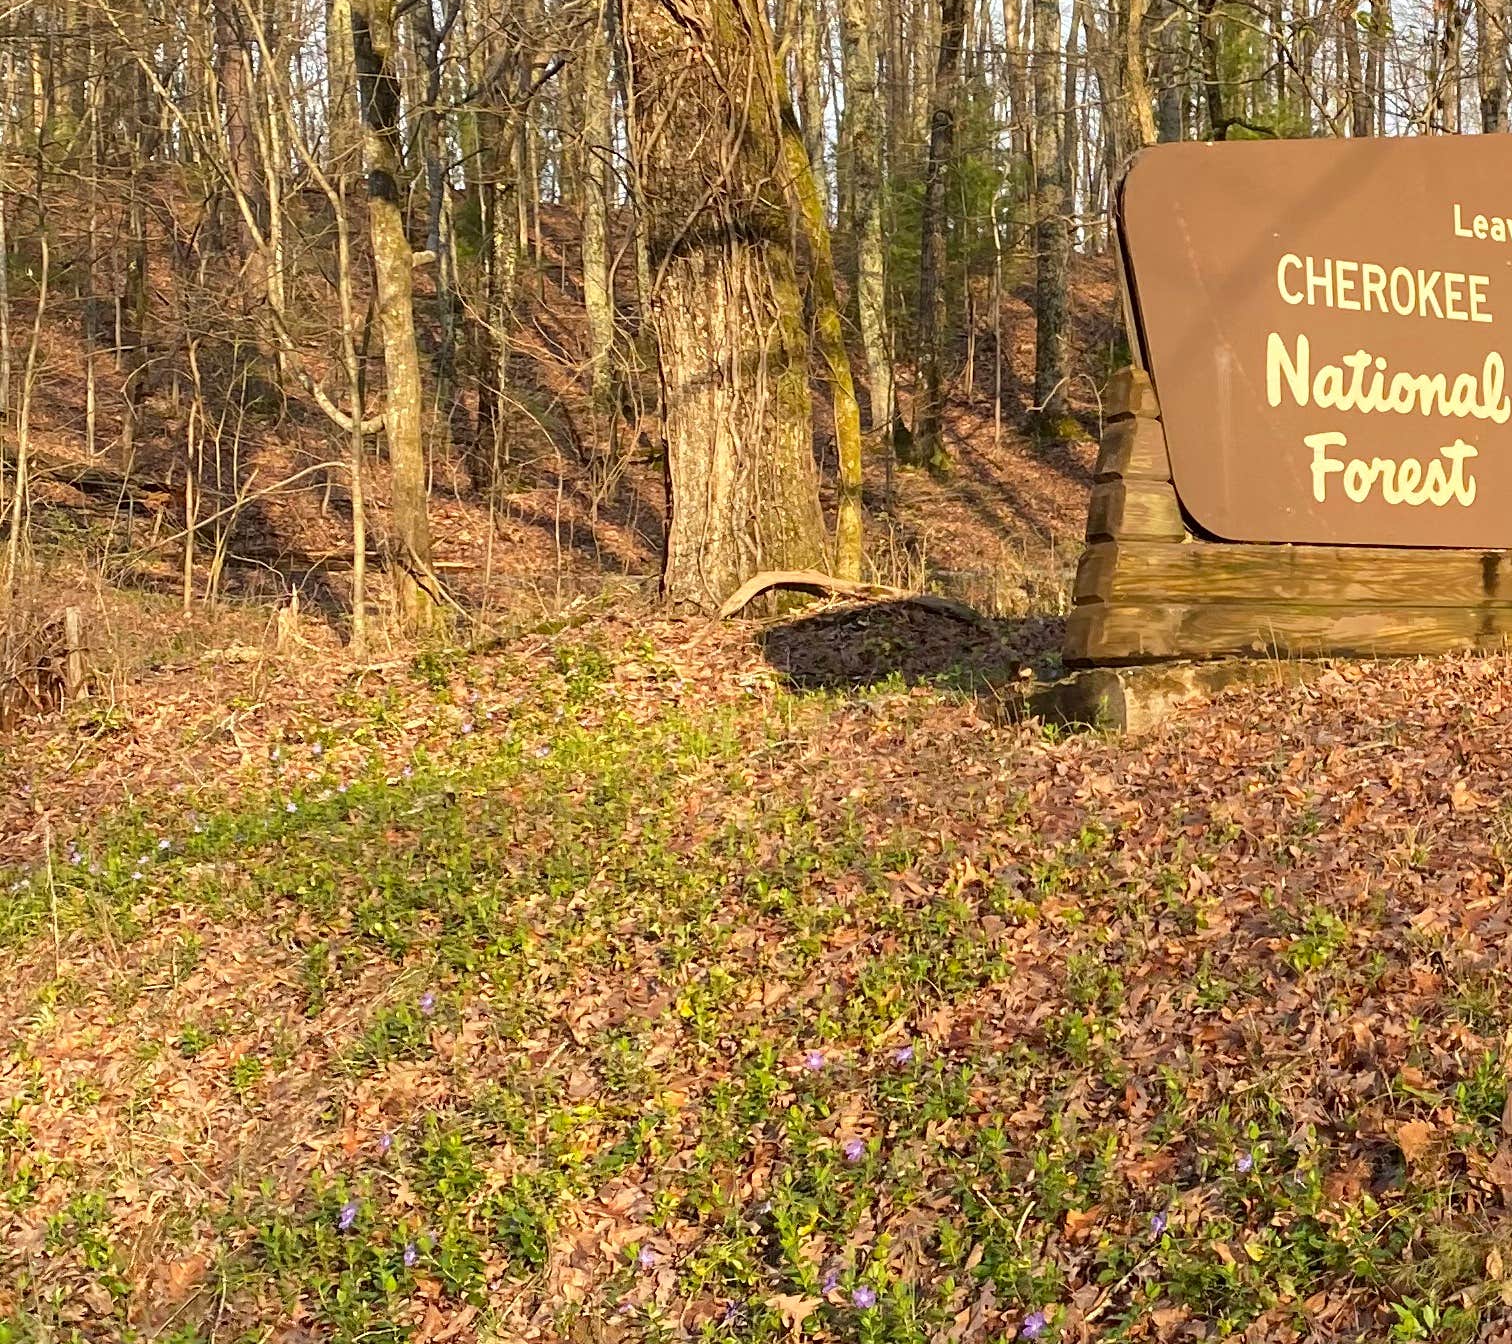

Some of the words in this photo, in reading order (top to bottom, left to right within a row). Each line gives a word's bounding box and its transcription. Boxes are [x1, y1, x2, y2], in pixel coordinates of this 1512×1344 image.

[1277, 253, 1493, 324] CHEROKEE
[1265, 332, 1512, 425] National
[1303, 431, 1479, 508] Forest
